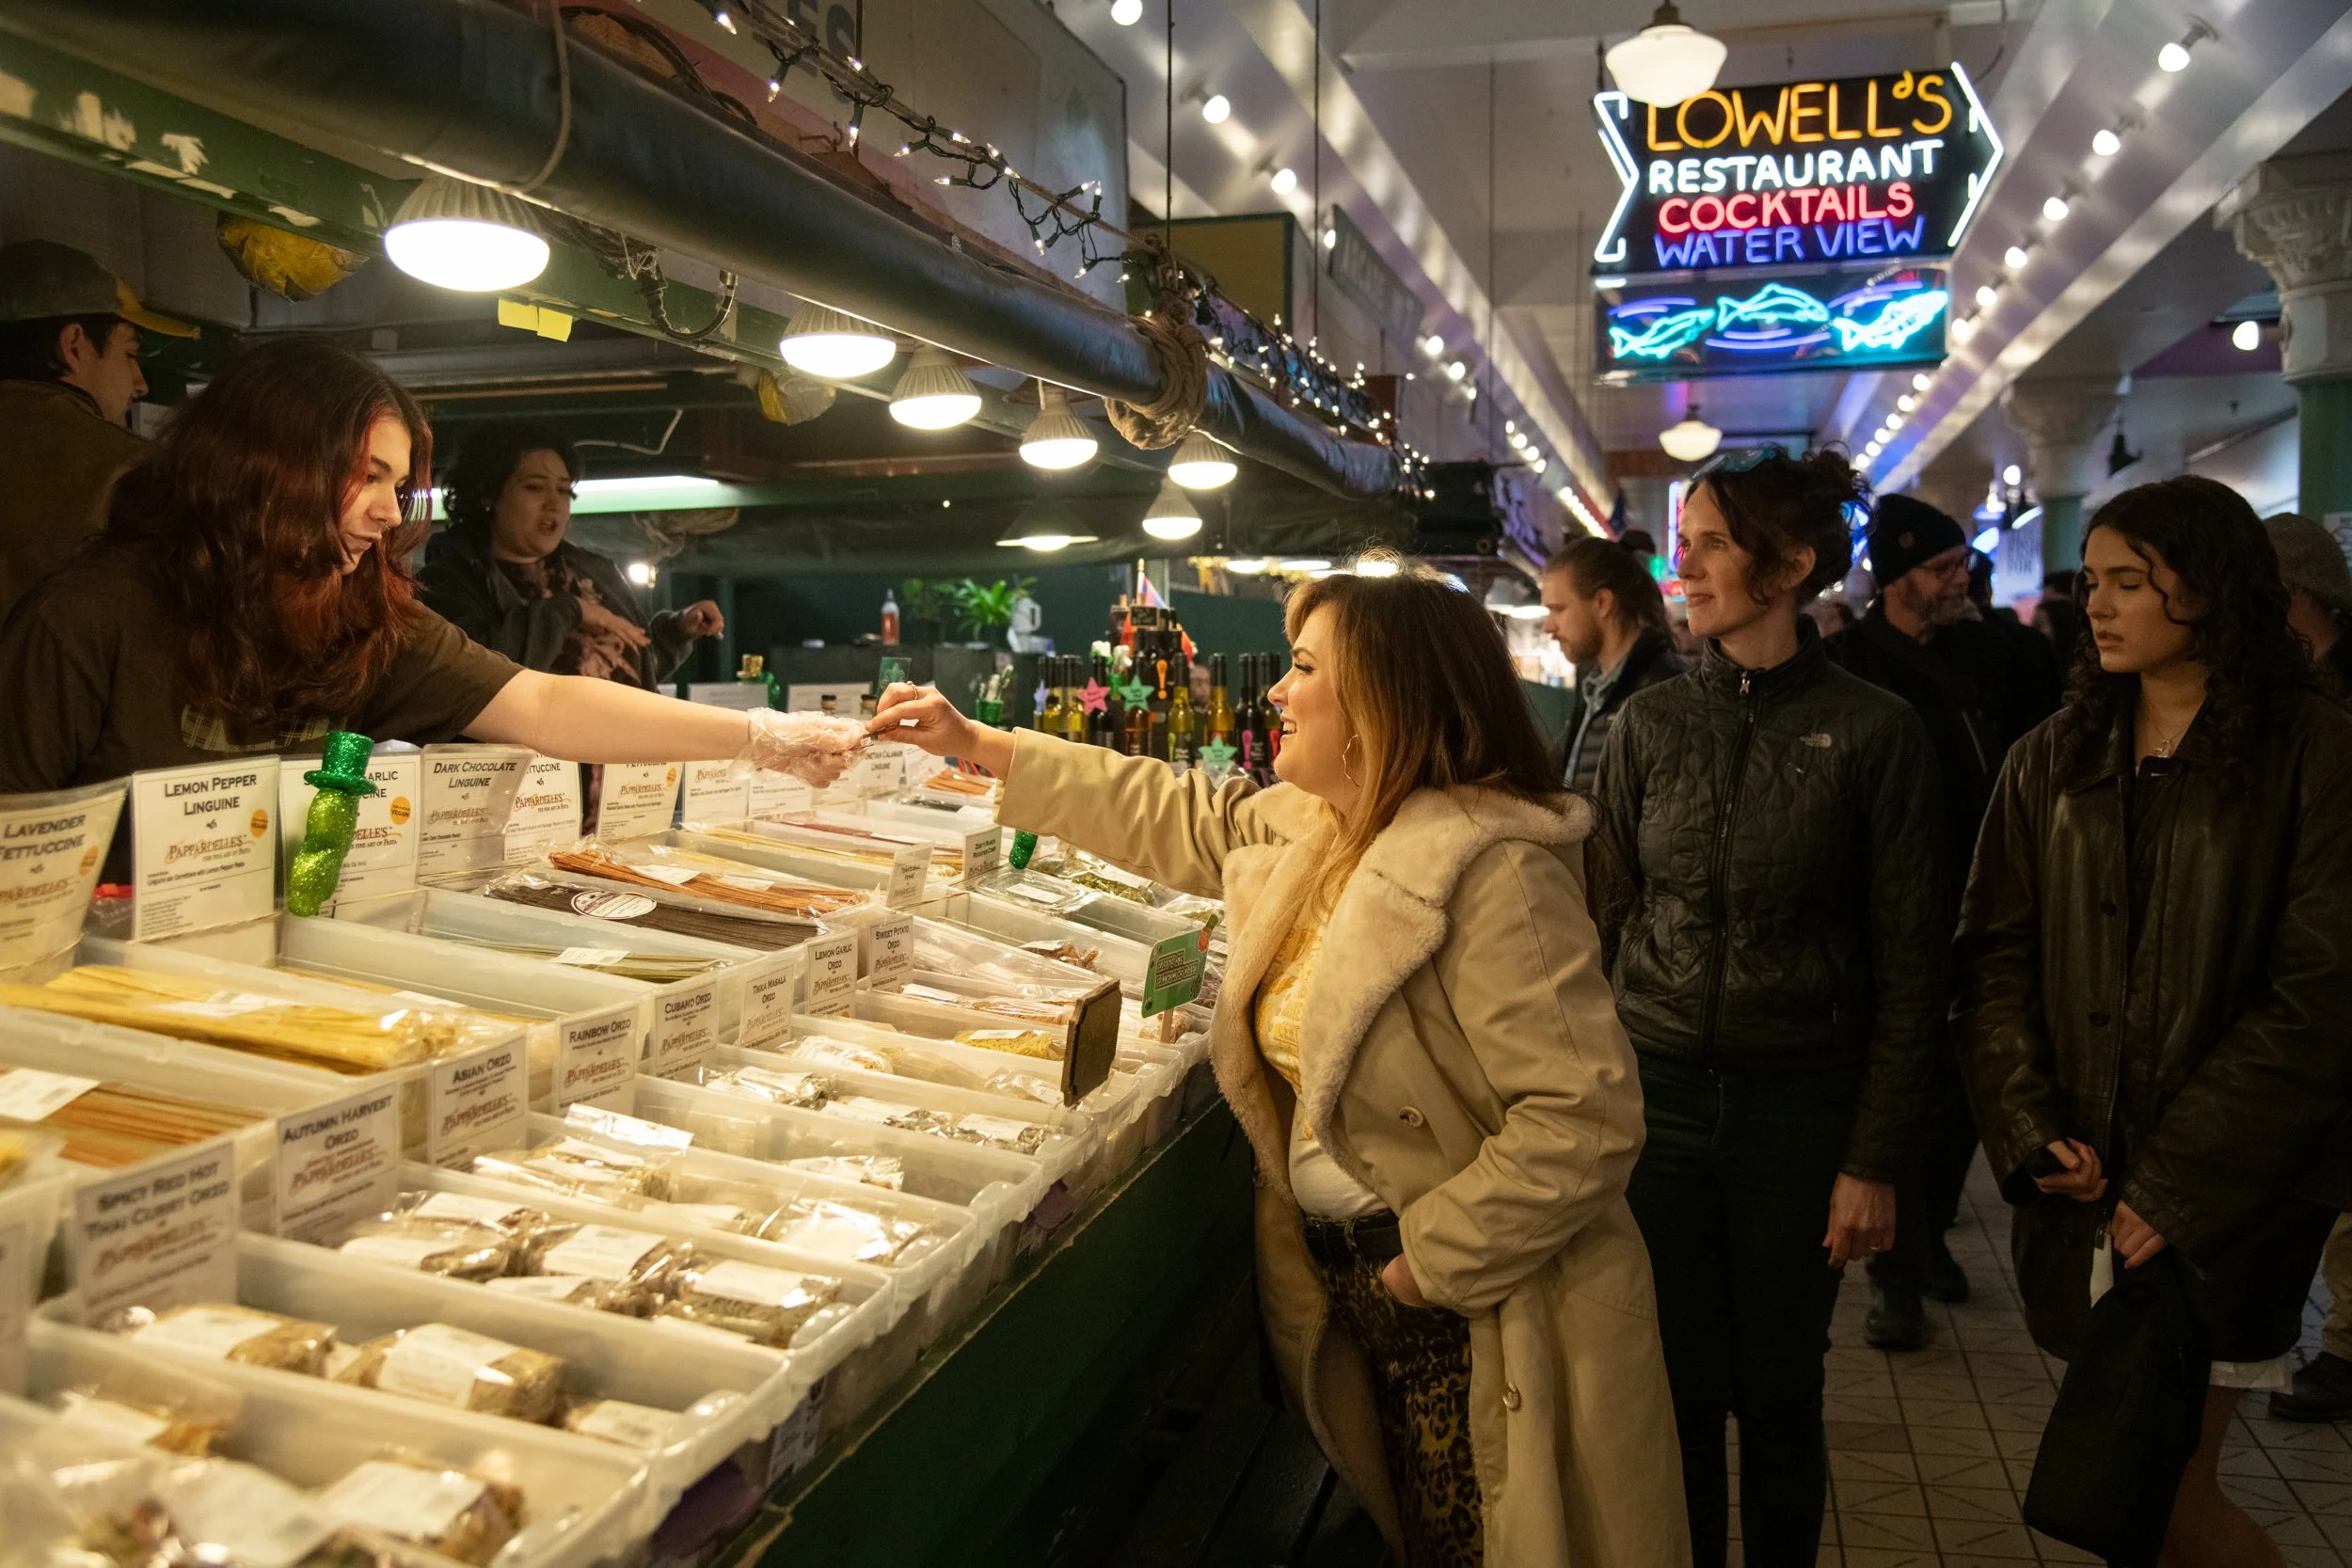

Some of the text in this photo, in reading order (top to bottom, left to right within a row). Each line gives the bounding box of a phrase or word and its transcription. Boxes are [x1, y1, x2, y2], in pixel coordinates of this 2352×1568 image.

[1646, 70, 1953, 151] LOWELL'S
[1649, 140, 1944, 194] RESTAURANT
[1658, 182, 1915, 233] COCKTAILS
[1654, 215, 1925, 268] WATER VIEW
[364, 770, 399, 783] ARLIC
[434, 761, 517, 774] DARK CHOCOLATE
[165, 774, 257, 798] LEMON PEPPER
[449, 778, 491, 788] LINGUINE
[183, 797, 240, 816] LINGUINE
[3, 815, 87, 838] LAVENDER
[0, 834, 86, 861] ETTUCCINE
[876, 926, 910, 940] SWEET POTATO
[816, 943, 852, 960] LEMON GARLIC
[887, 941, 899, 950] ORZO
[828, 959, 842, 971] ORZO
[768, 975, 787, 989] MASALA
[665, 998, 694, 1014] CUBANO
[695, 992, 711, 1005] ORZO
[762, 992, 775, 1004] ORZO
[569, 1023, 610, 1043] RAINBOW
[611, 1019, 631, 1033] ORZO
[453, 1066, 485, 1085] ASIAN
[486, 1053, 512, 1072] ORZO
[283, 1095, 393, 1144] AUTUMN HARVEST
[325, 1129, 359, 1149] ORZO
